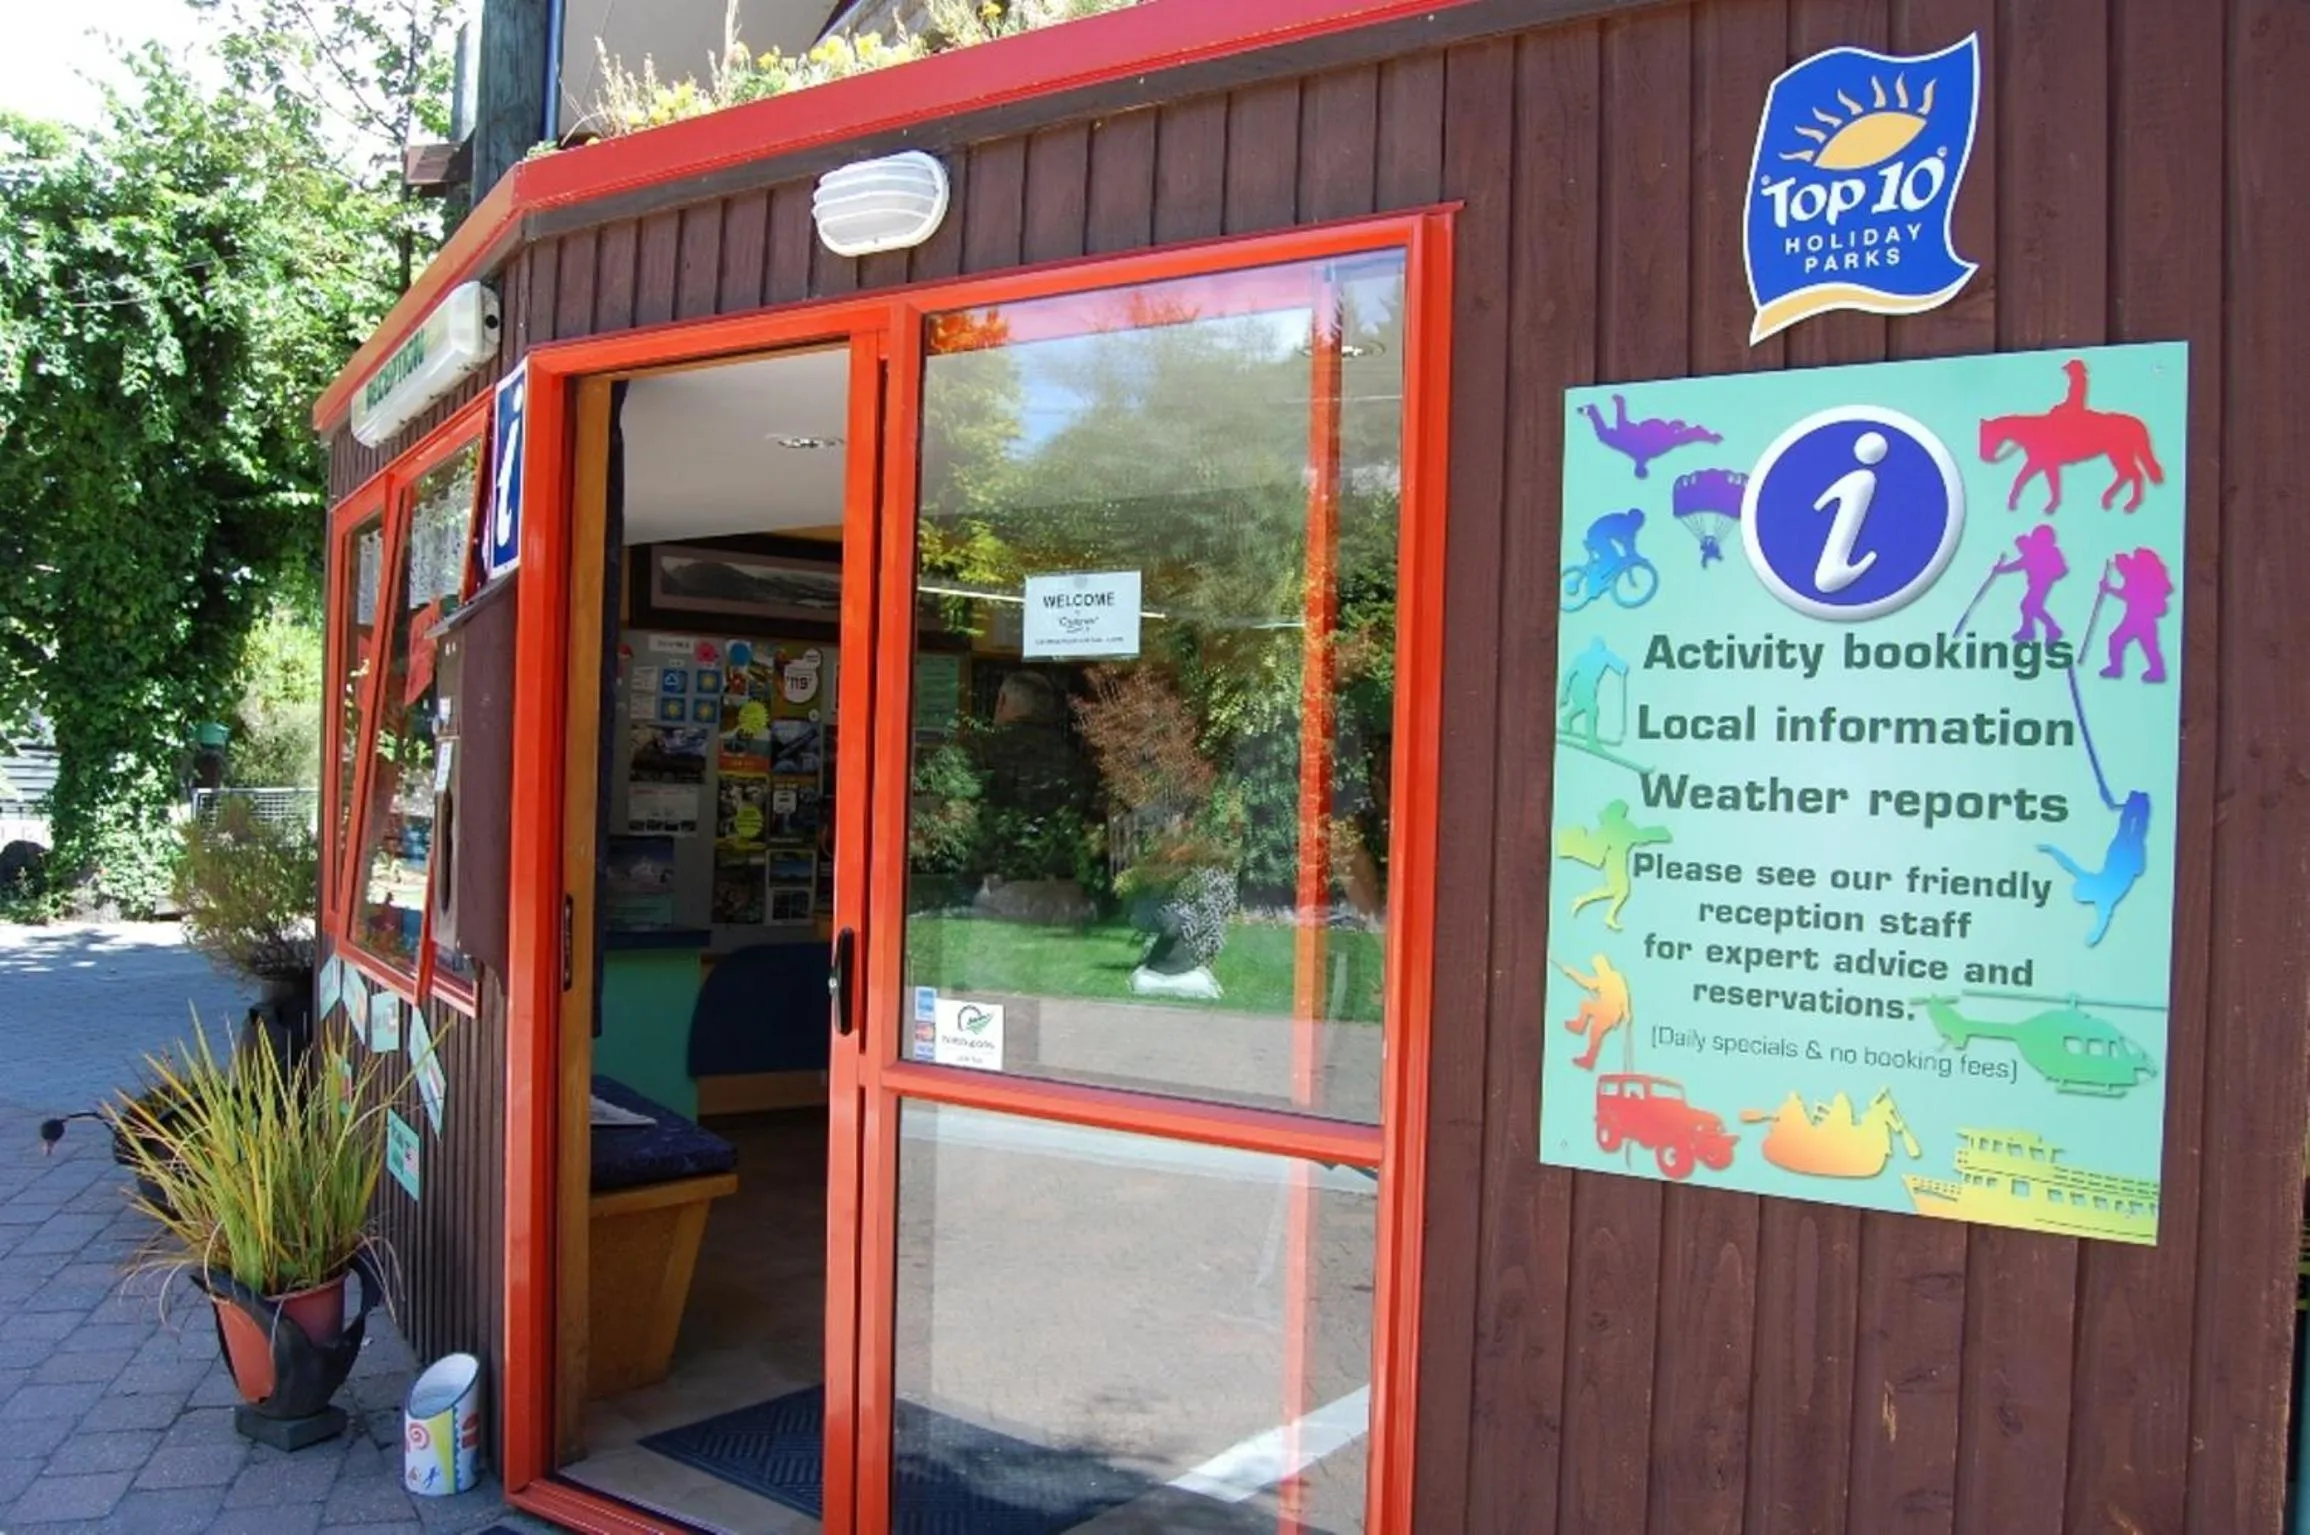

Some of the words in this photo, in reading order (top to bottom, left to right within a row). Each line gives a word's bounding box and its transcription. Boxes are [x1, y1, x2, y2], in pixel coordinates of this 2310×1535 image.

[1870, 157, 1946, 213] 10
[1785, 222, 1922, 255] HOLIDAY
[1804, 248, 1901, 274] PARKS
[1042, 592, 1116, 609] WELCOME
[1643, 633, 1824, 679] Activity
[1843, 632, 2074, 680] bookings
[1638, 704, 1756, 741] Local
[1776, 706, 2075, 747] information
[1640, 772, 1849, 814] Weather
[1869, 786, 2069, 829] reports
[1633, 852, 1743, 884] Please
[1756, 863, 1816, 888] see
[1830, 868, 1893, 892] our
[1906, 866, 2052, 908] friendly
[1698, 899, 1864, 935] reception
[1879, 909, 1972, 939] staff
[1643, 932, 1693, 961] for
[1706, 941, 1819, 974] expert
[1833, 947, 1949, 982] advice
[1963, 958, 2034, 988] and
[1692, 980, 1915, 1021] reservations.
[1712, 1032, 1798, 1060] specials
[1805, 1040, 1823, 1060] &
[1830, 1046, 1858, 1064] no
[1864, 1047, 1952, 1078] booking
